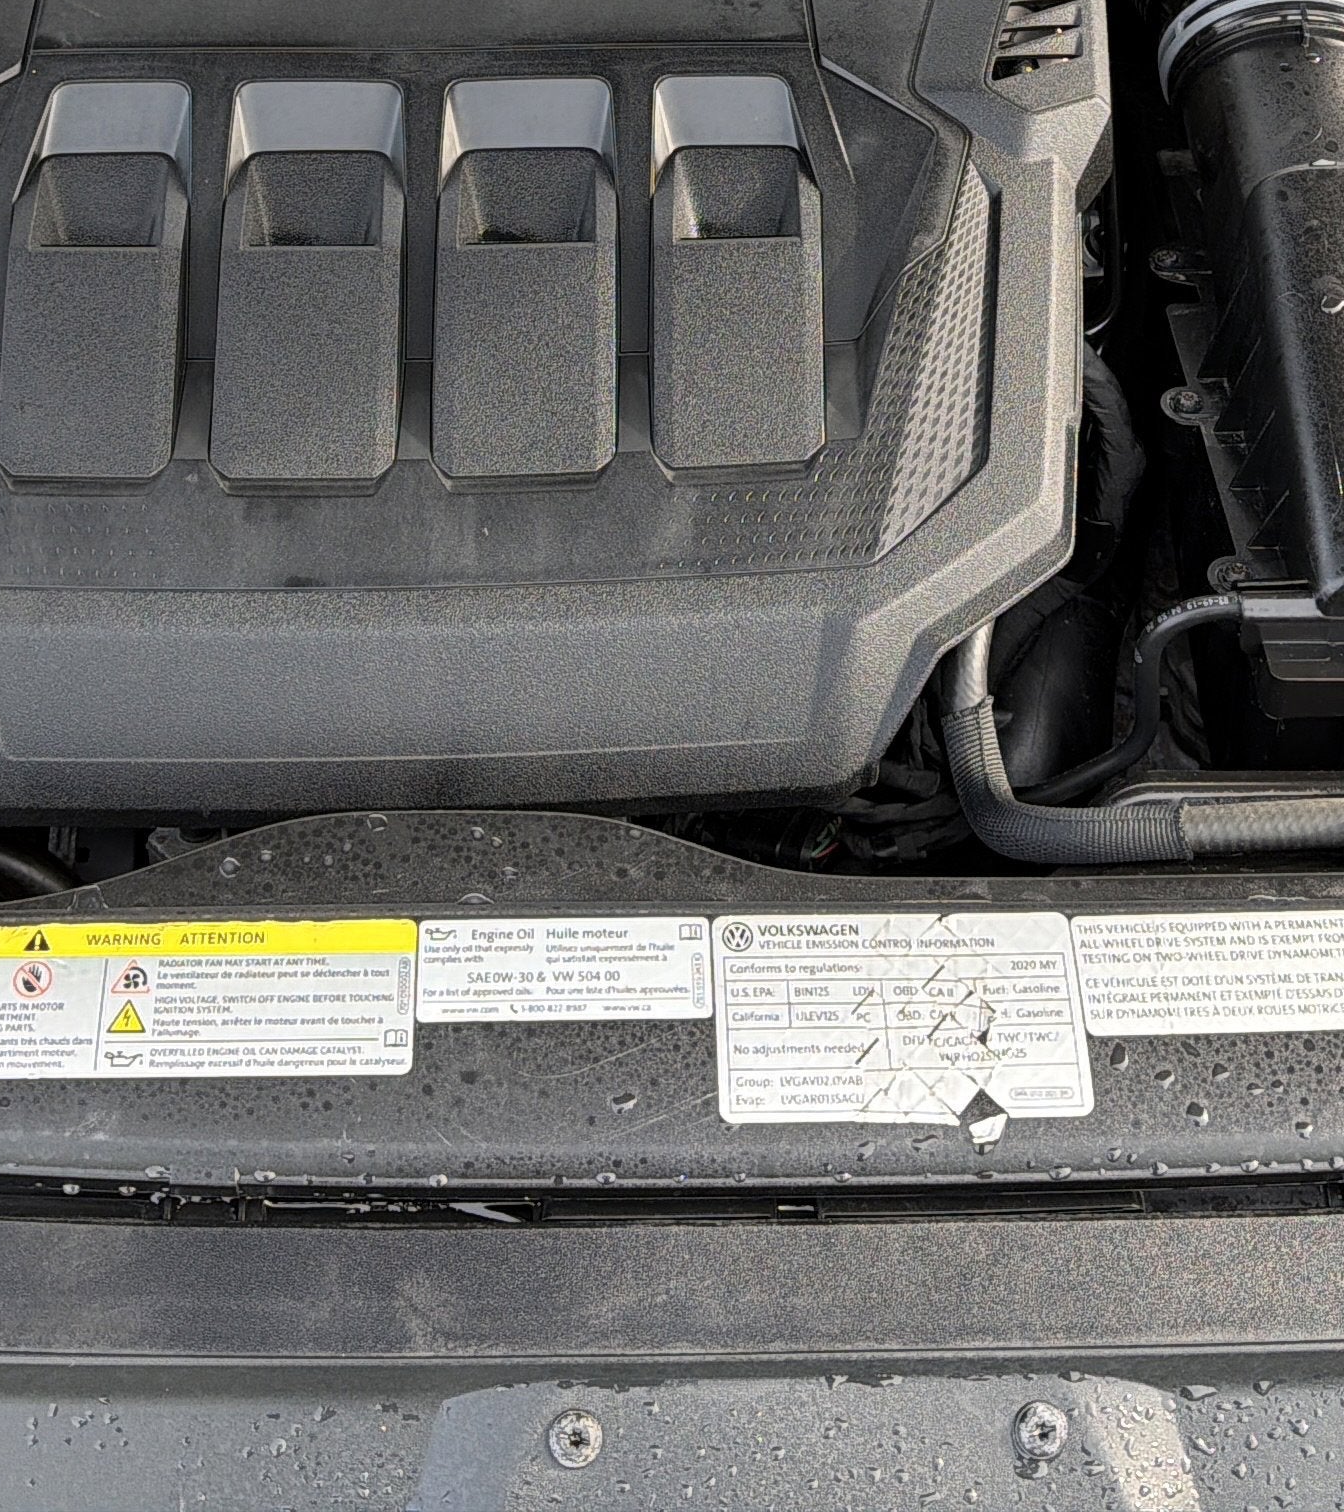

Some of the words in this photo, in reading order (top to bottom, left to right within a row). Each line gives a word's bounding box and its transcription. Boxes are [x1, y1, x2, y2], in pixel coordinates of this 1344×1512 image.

[757, 924, 859, 937] VOLKSWAGEN
[1076, 924, 1104, 935] THIS
[1105, 923, 1154, 934] VEHICLE
[1155, 922, 1167, 933] IS
[1169, 921, 1228, 933] EQUIPPED
[1229, 920, 1261, 931] WITH
[1263, 920, 1272, 931] A
[1274, 918, 1344, 930] PERMANENT
[85, 932, 161, 946] WARNING
[179, 931, 265, 945] ATTENTION
[471, 928, 514, 943] Engine
[516, 928, 535, 940] Oil
[546, 928, 580, 940] Huile
[582, 927, 629, 940] moteur
[758, 940, 802, 949] VEHICLE
[806, 940, 859, 949] EMISSION
[862, 939, 912, 949] CONTROL
[918, 938, 995, 948] INFORMATION
[1146, 937, 1182, 948] DRIVE
[1183, 936, 1227, 947] SYSTEM
[1229, 935, 1256, 946] AND
[1258, 935, 1269, 945] IS
[1271, 934, 1316, 945] EXEMPT
[158, 958, 203, 967] RADIATOR
[205, 958, 223, 967] FAN
[224, 958, 243, 967] MAY
[245, 958, 272, 966] START
[273, 958, 284, 966] AT
[286, 957, 304, 966] ANY
[305, 957, 329, 966] TIME.
[1082, 953, 1131, 964] TESTING
[1132, 952, 1153, 963] ON
[1230, 950, 1267, 961] DRIVE
[729, 963, 782, 974] Conforms
[785, 964, 796, 973] to
[1010, 960, 1037, 970] 2020
[1039, 960, 1057, 970] MY
[157, 971, 168, 979] Le
[169, 971, 219, 979] ventilateur
[220, 970, 233, 979] de
[234, 970, 275, 979] radiateur
[277, 970, 298, 978] peut
[300, 970, 311, 978] se
[312, 969, 361, 978] déclencher
[363, 969, 369, 978] à
[370, 969, 390, 978] tout
[466, 972, 492, 983] SAE
[536, 971, 546, 982] &
[552, 971, 576, 982] VW
[578, 970, 601, 981] 504
[604, 970, 621, 981] 00
[730, 987, 751, 998] U.S.
[794, 986, 830, 997] BIN125
[928, 987, 945, 997] CA
[1013, 984, 1061, 995] Gasoline
[155, 995, 178, 1004] HIGH
[222, 995, 256, 1003] SWITCH
[257, 995, 275, 1003] OFF
[277, 994, 310, 1003] ENGINE
[312, 994, 347, 1003] BEFORE
[349, 994, 394, 1002] TOUCHING
[20, 1003, 30, 1011] IN
[31, 1002, 64, 1011] MOTOR
[153, 1005, 194, 1015] IGNITION
[856, 1012, 871, 1023] PC
[1016, 1008, 1064, 1018] Gasoline
[5, 1024, 35, 1032] PARTS.
[38, 1037, 69, 1046] chauds
[72, 1036, 93, 1045] dans
[41, 1048, 77, 1057] moteur.
[150, 1048, 204, 1057] OVERFILLED
[206, 1047, 240, 1056] ENGINE
[242, 1047, 257, 1056] OIL
[258, 1047, 278, 1056] CAN
[280, 1047, 318, 1055] DAMAGE
[320, 1046, 364, 1055] CATALYST.
[733, 1044, 750, 1054] No
[752, 1043, 821, 1057] adjustments
[736, 1076, 773, 1089] Group:
